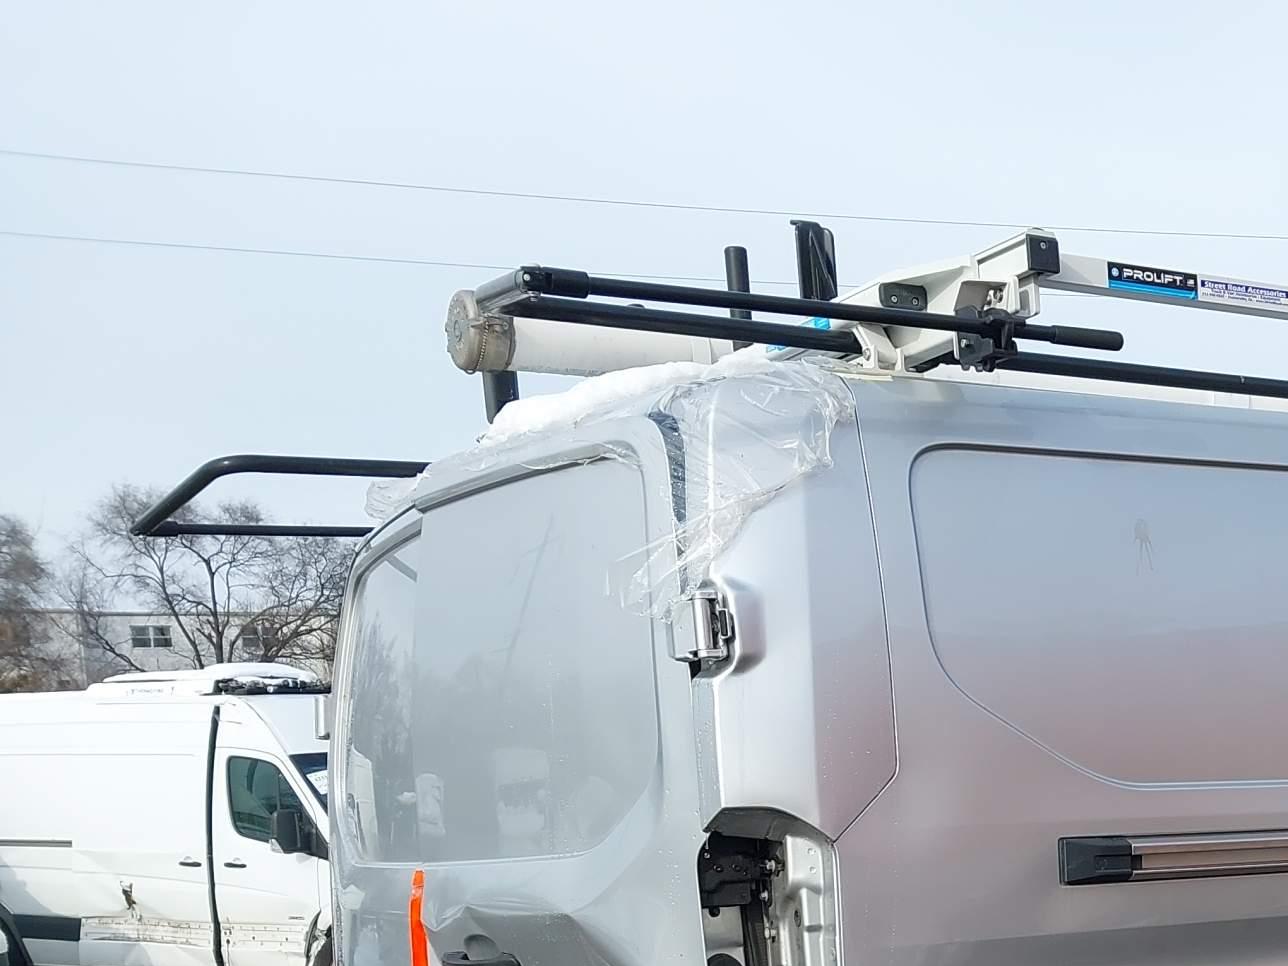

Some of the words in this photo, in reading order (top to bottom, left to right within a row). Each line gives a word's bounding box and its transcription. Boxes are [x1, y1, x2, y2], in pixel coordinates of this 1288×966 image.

[1122, 268, 1183, 286] PROLIFT
[1204, 281, 1226, 291] Street
[1247, 286, 1287, 298] Accessories
